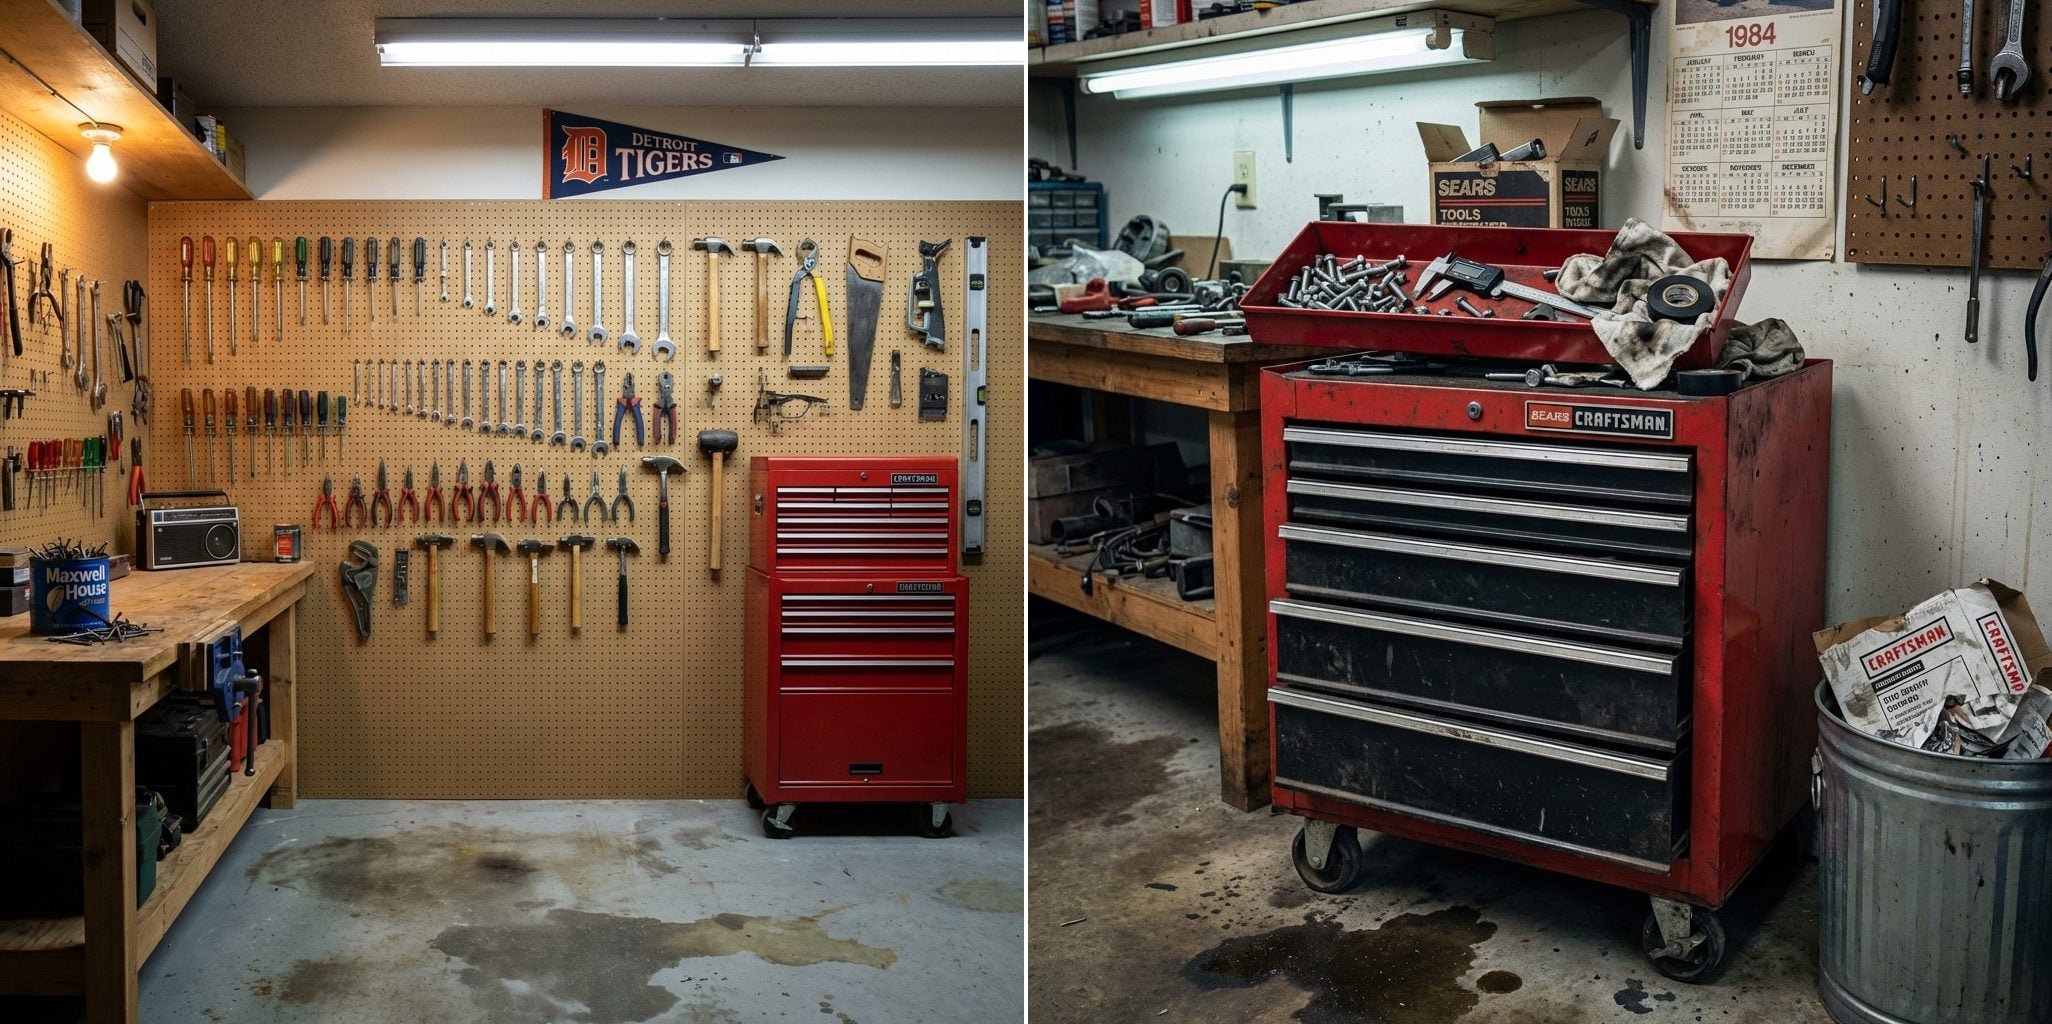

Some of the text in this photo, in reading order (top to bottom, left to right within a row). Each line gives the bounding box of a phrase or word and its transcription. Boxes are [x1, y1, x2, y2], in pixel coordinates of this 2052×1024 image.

[1725, 22, 1777, 48] 1984
[632, 132, 698, 152] DETROIT
[615, 148, 713, 181] TIGERS
[1438, 178, 1497, 196] SEARS
[1440, 208, 1481, 221] TOOLS
[46, 565, 106, 584] Maxwell
[1867, 624, 1948, 671] CRAFTSMAN
